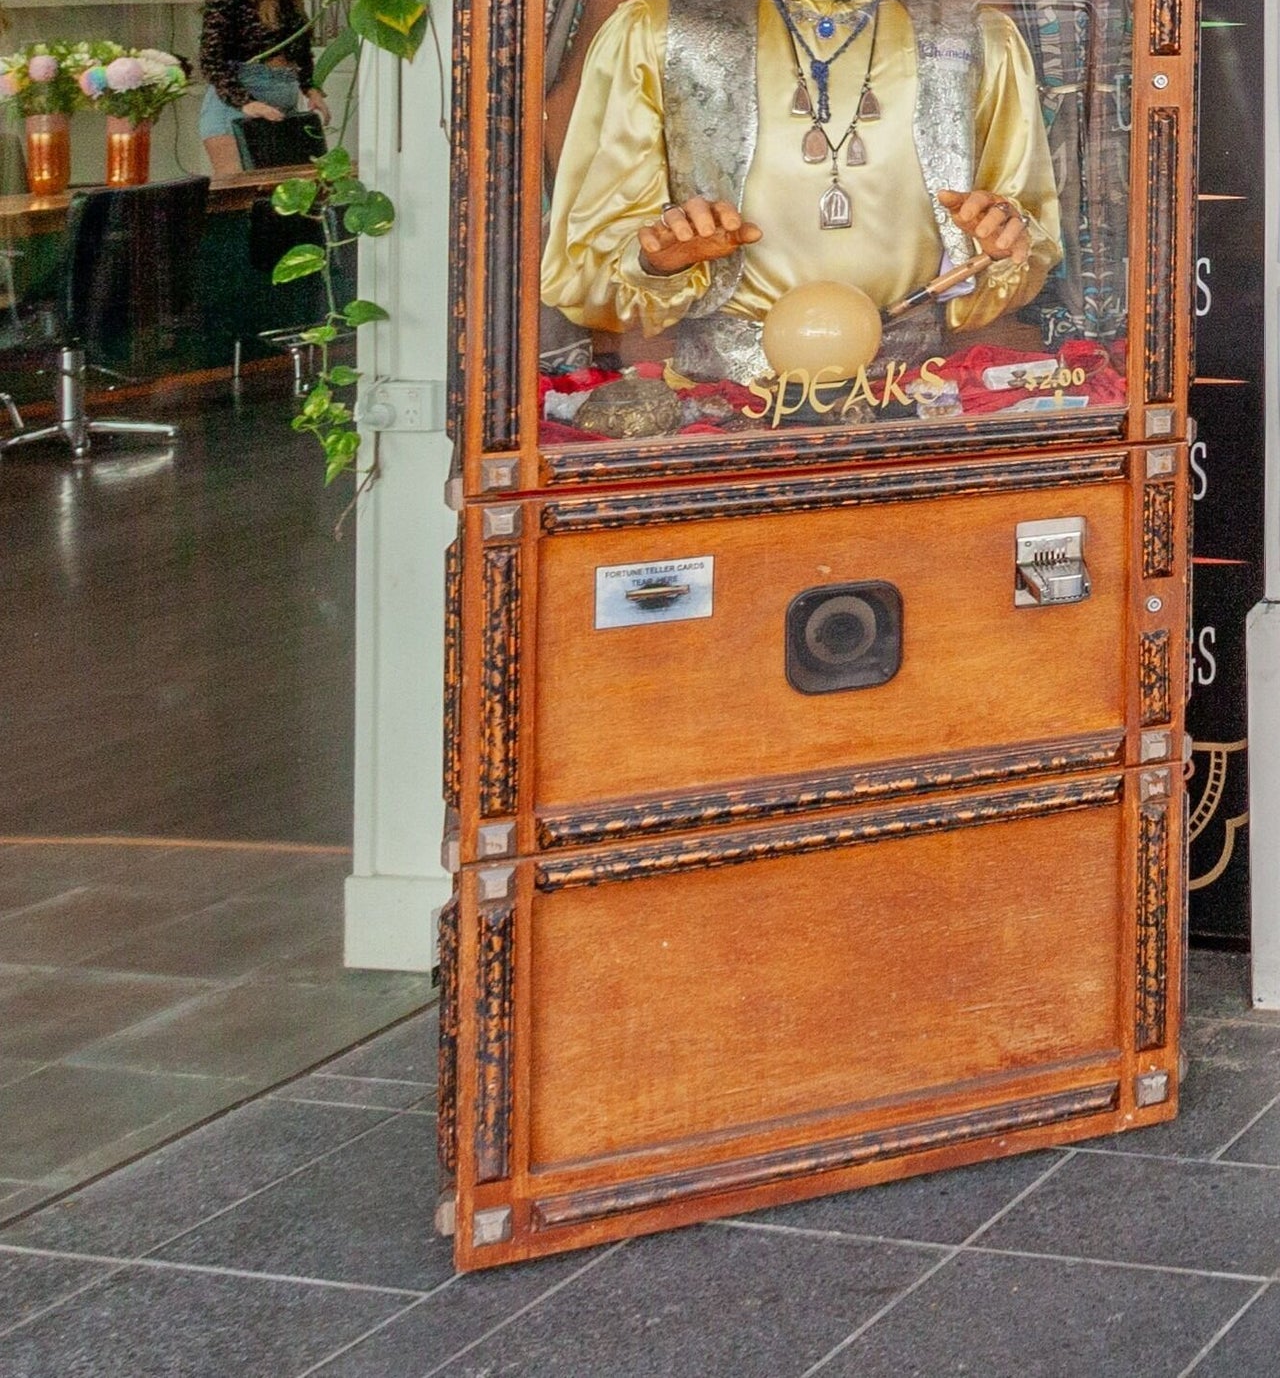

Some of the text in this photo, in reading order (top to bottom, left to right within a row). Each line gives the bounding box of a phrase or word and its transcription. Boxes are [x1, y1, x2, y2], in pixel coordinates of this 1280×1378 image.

[1024, 367, 1085, 392] $2.00
[741, 357, 947, 429] SPEAKS
[605, 562, 705, 579] FORTUNE TELLER CARDS
